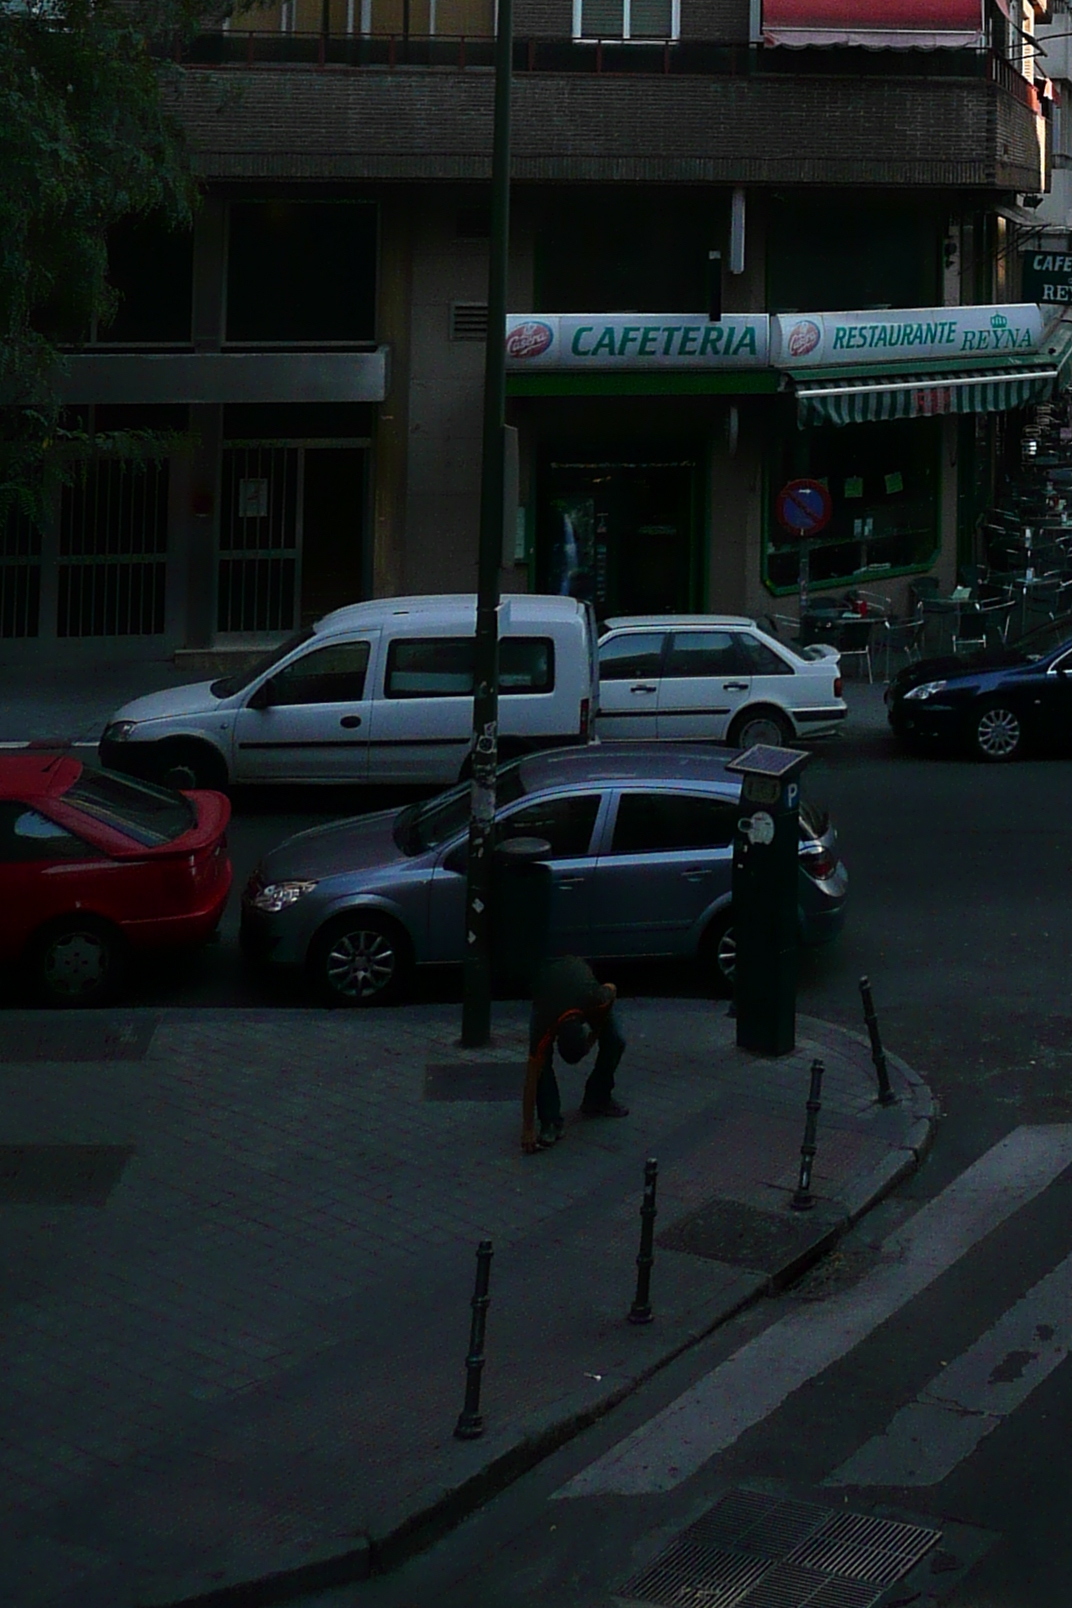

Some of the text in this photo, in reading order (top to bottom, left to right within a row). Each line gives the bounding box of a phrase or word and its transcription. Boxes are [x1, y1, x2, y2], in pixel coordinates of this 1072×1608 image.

[571, 325, 757, 357] CAFETERIA
[832, 321, 1033, 352] RESTAURANTE REYNA
[787, 782, 799, 808] P
